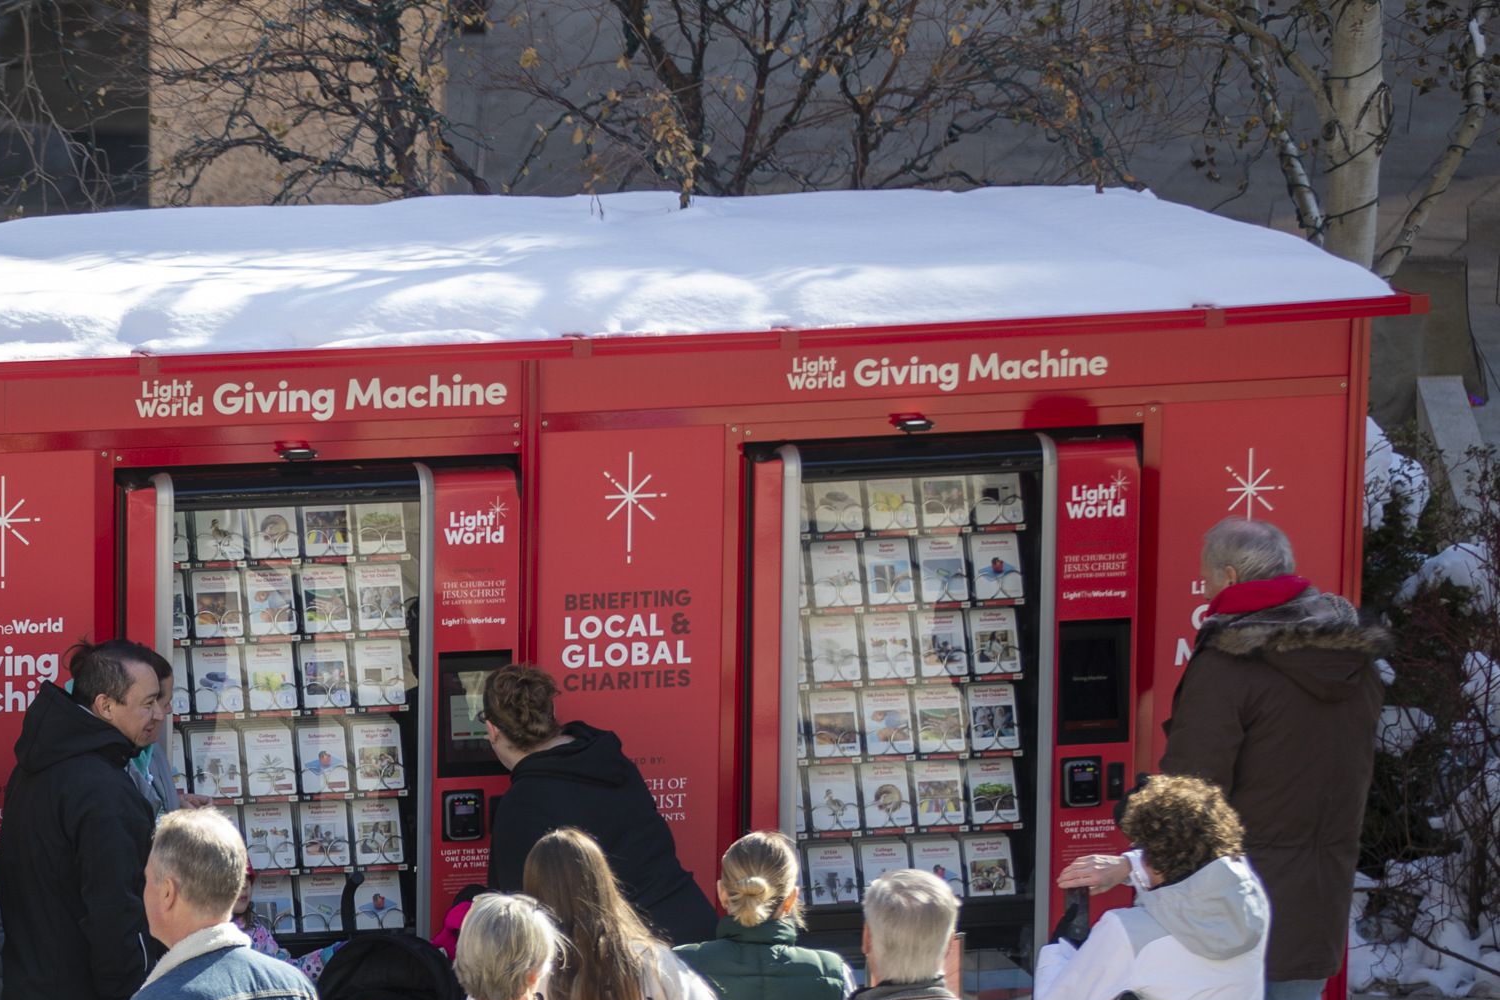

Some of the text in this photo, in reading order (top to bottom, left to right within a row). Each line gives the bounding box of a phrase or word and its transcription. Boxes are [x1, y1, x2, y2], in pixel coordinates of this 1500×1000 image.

[792, 356, 837, 376] Light
[853, 348, 1109, 392] Giving Machine
[142, 379, 193, 402] Light
[786, 371, 846, 390] World
[135, 396, 203, 418] World
[213, 374, 507, 421] Giving Machine
[1072, 483, 1116, 505] Light
[1066, 499, 1126, 519] World
[450, 510, 495, 531] Light
[444, 525, 504, 545] World
[1064, 562, 1127, 573] JESUS CHRIST
[1081, 554, 1115, 562] CHURCH
[460, 580, 494, 588] CHURCH
[496, 579, 506, 587] OF
[443, 588, 506, 600] JESUS CHRIST
[565, 589, 691, 612] BENEFITING
[564, 612, 691, 640] LOCAL &
[561, 641, 692, 668] GLOBAL
[563, 669, 691, 692] CHARITIES
[668, 778, 687, 790] OF
[652, 793, 686, 809] IST
